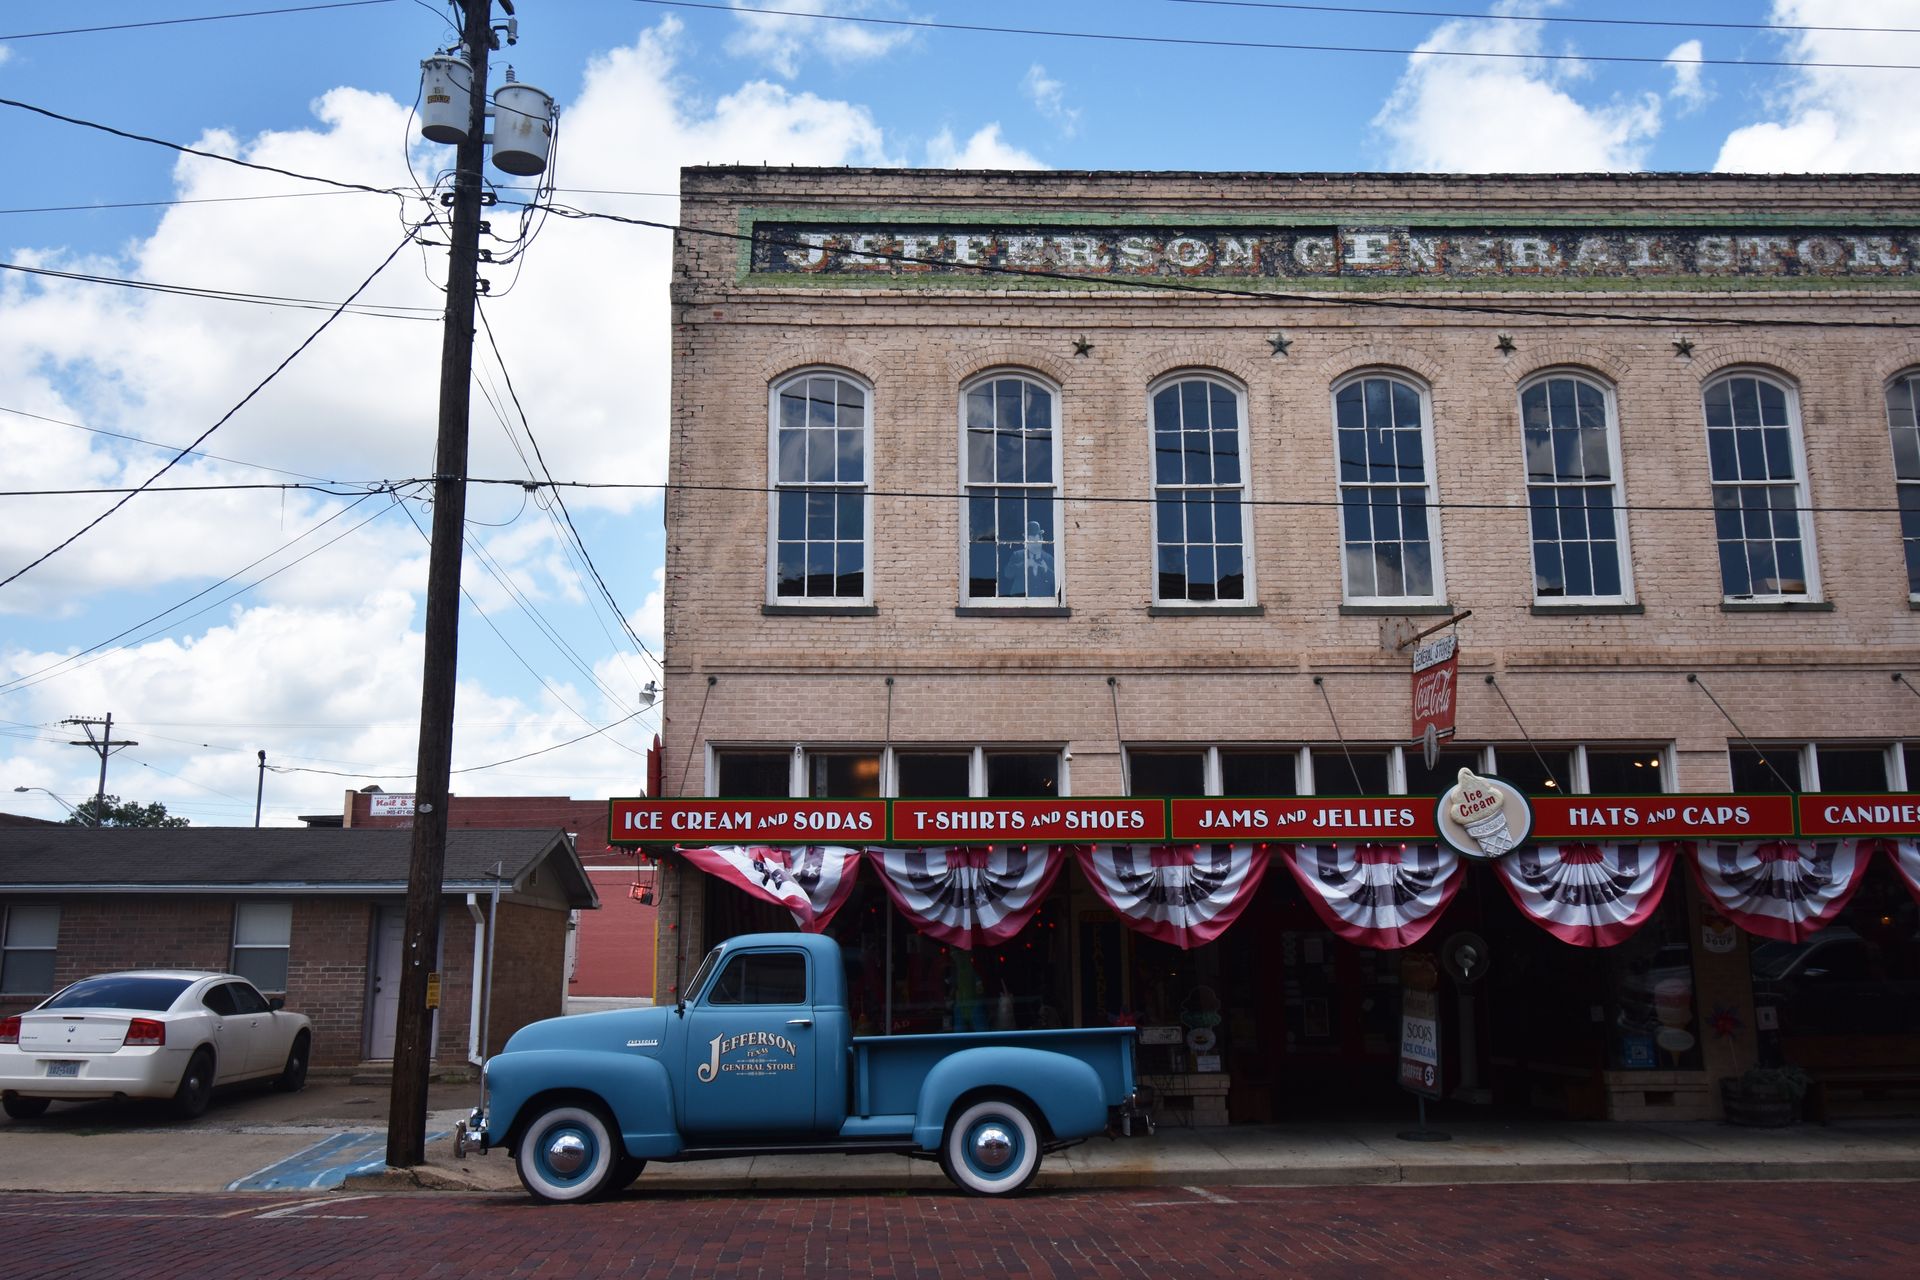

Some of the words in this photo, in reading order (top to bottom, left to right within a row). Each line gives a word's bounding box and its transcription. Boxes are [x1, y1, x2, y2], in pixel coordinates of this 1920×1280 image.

[782, 231, 1263, 272] JEFFERSON
[1293, 233, 1675, 273] GENERAL
[1693, 234, 1920, 274] STOR
[1463, 789, 1483, 803] Ice
[1459, 795, 1496, 818] Cream
[1568, 807, 1639, 827] HATS
[1646, 807, 1676, 825] AND
[1682, 806, 1751, 826] CAPS
[1823, 805, 1920, 825] CANDIE
[624, 811, 663, 830] ICE
[671, 811, 752, 831] CREAM
[757, 811, 788, 830] AND
[793, 811, 873, 831] SODAS
[913, 811, 1026, 830] T-SHIRTS
[1030, 810, 1061, 828] AND
[1065, 810, 1145, 830] SHOES
[1198, 809, 1269, 828] JAMS
[1276, 809, 1307, 826] AND
[1312, 808, 1415, 828] JELLIES
[697, 1031, 798, 1083] JEFFERSON
[747, 1047, 769, 1057] TEXAS
[721, 1063, 765, 1072] GENERAL
[766, 1062, 797, 1071] STORE
